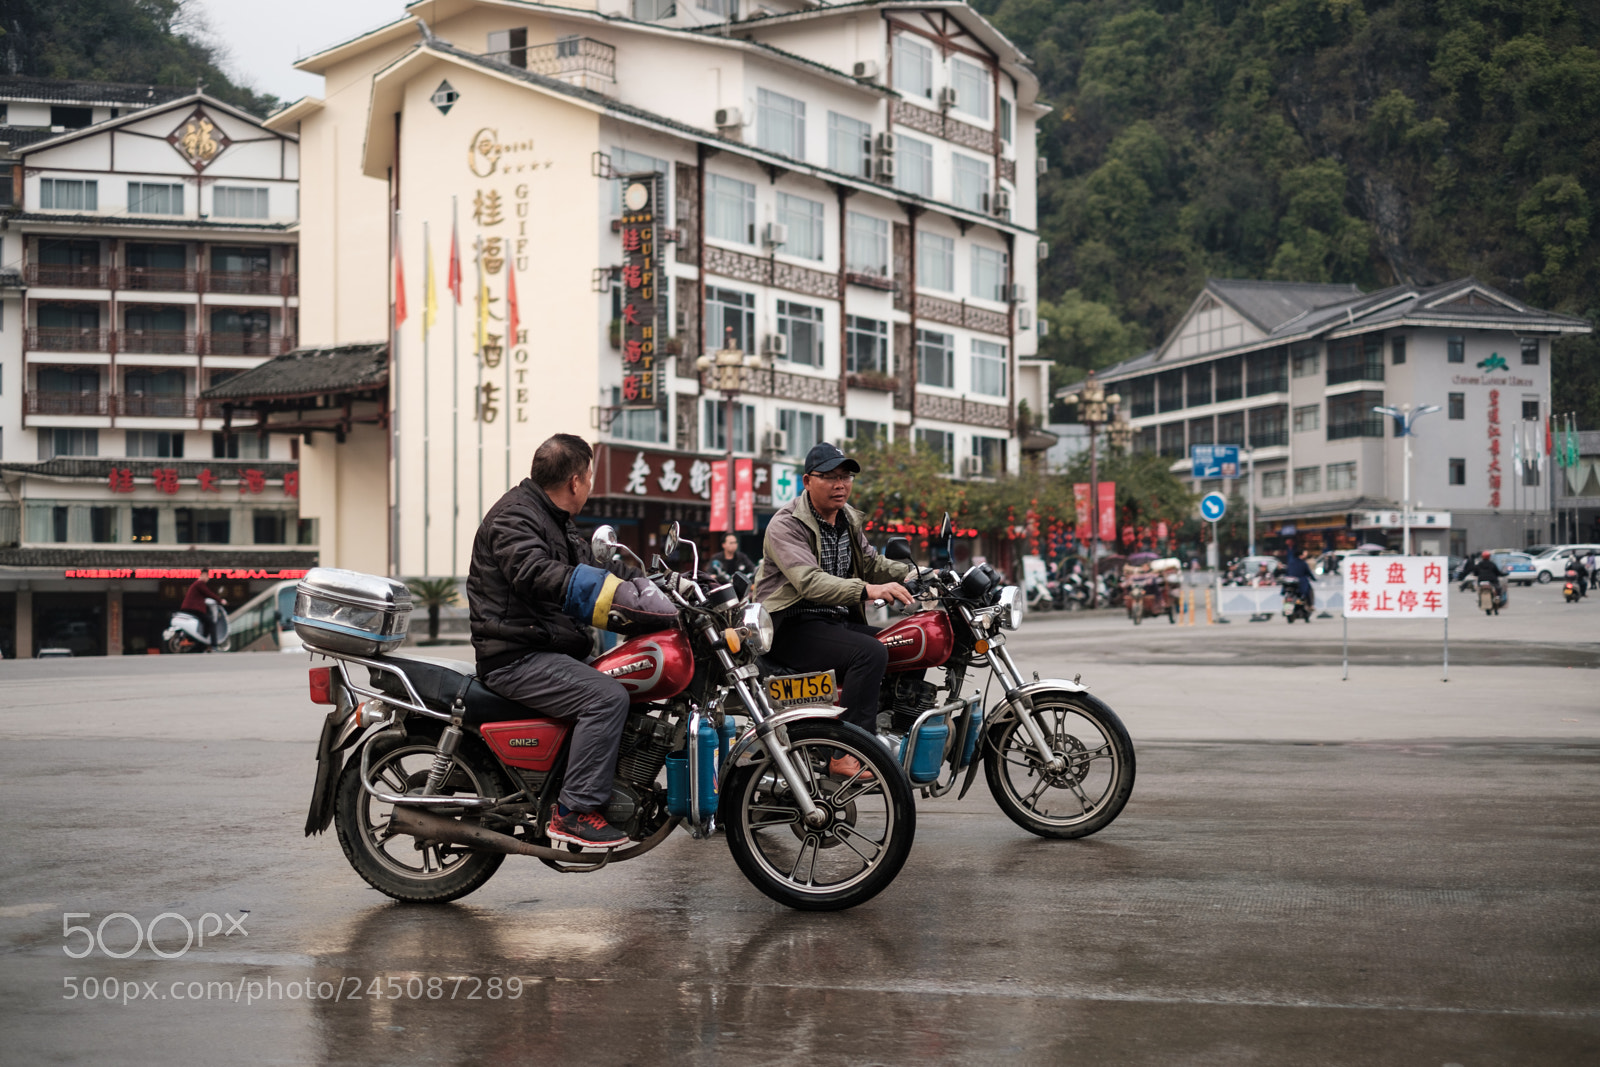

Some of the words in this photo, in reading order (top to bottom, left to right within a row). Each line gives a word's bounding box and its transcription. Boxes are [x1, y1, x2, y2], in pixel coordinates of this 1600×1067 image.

[515, 184, 529, 272] GUIFU
[641, 228, 652, 299] GUIFU
[622, 228, 642, 400] 桂福大酒店
[515, 329, 528, 423] HOTEL
[641, 326, 653, 399] HOTEL
[1349, 561, 1442, 585] 转盘内
[1349, 589, 1443, 613] 禁止停车
[769, 675, 832, 700] SW756
[509, 738, 538, 747] GN125
